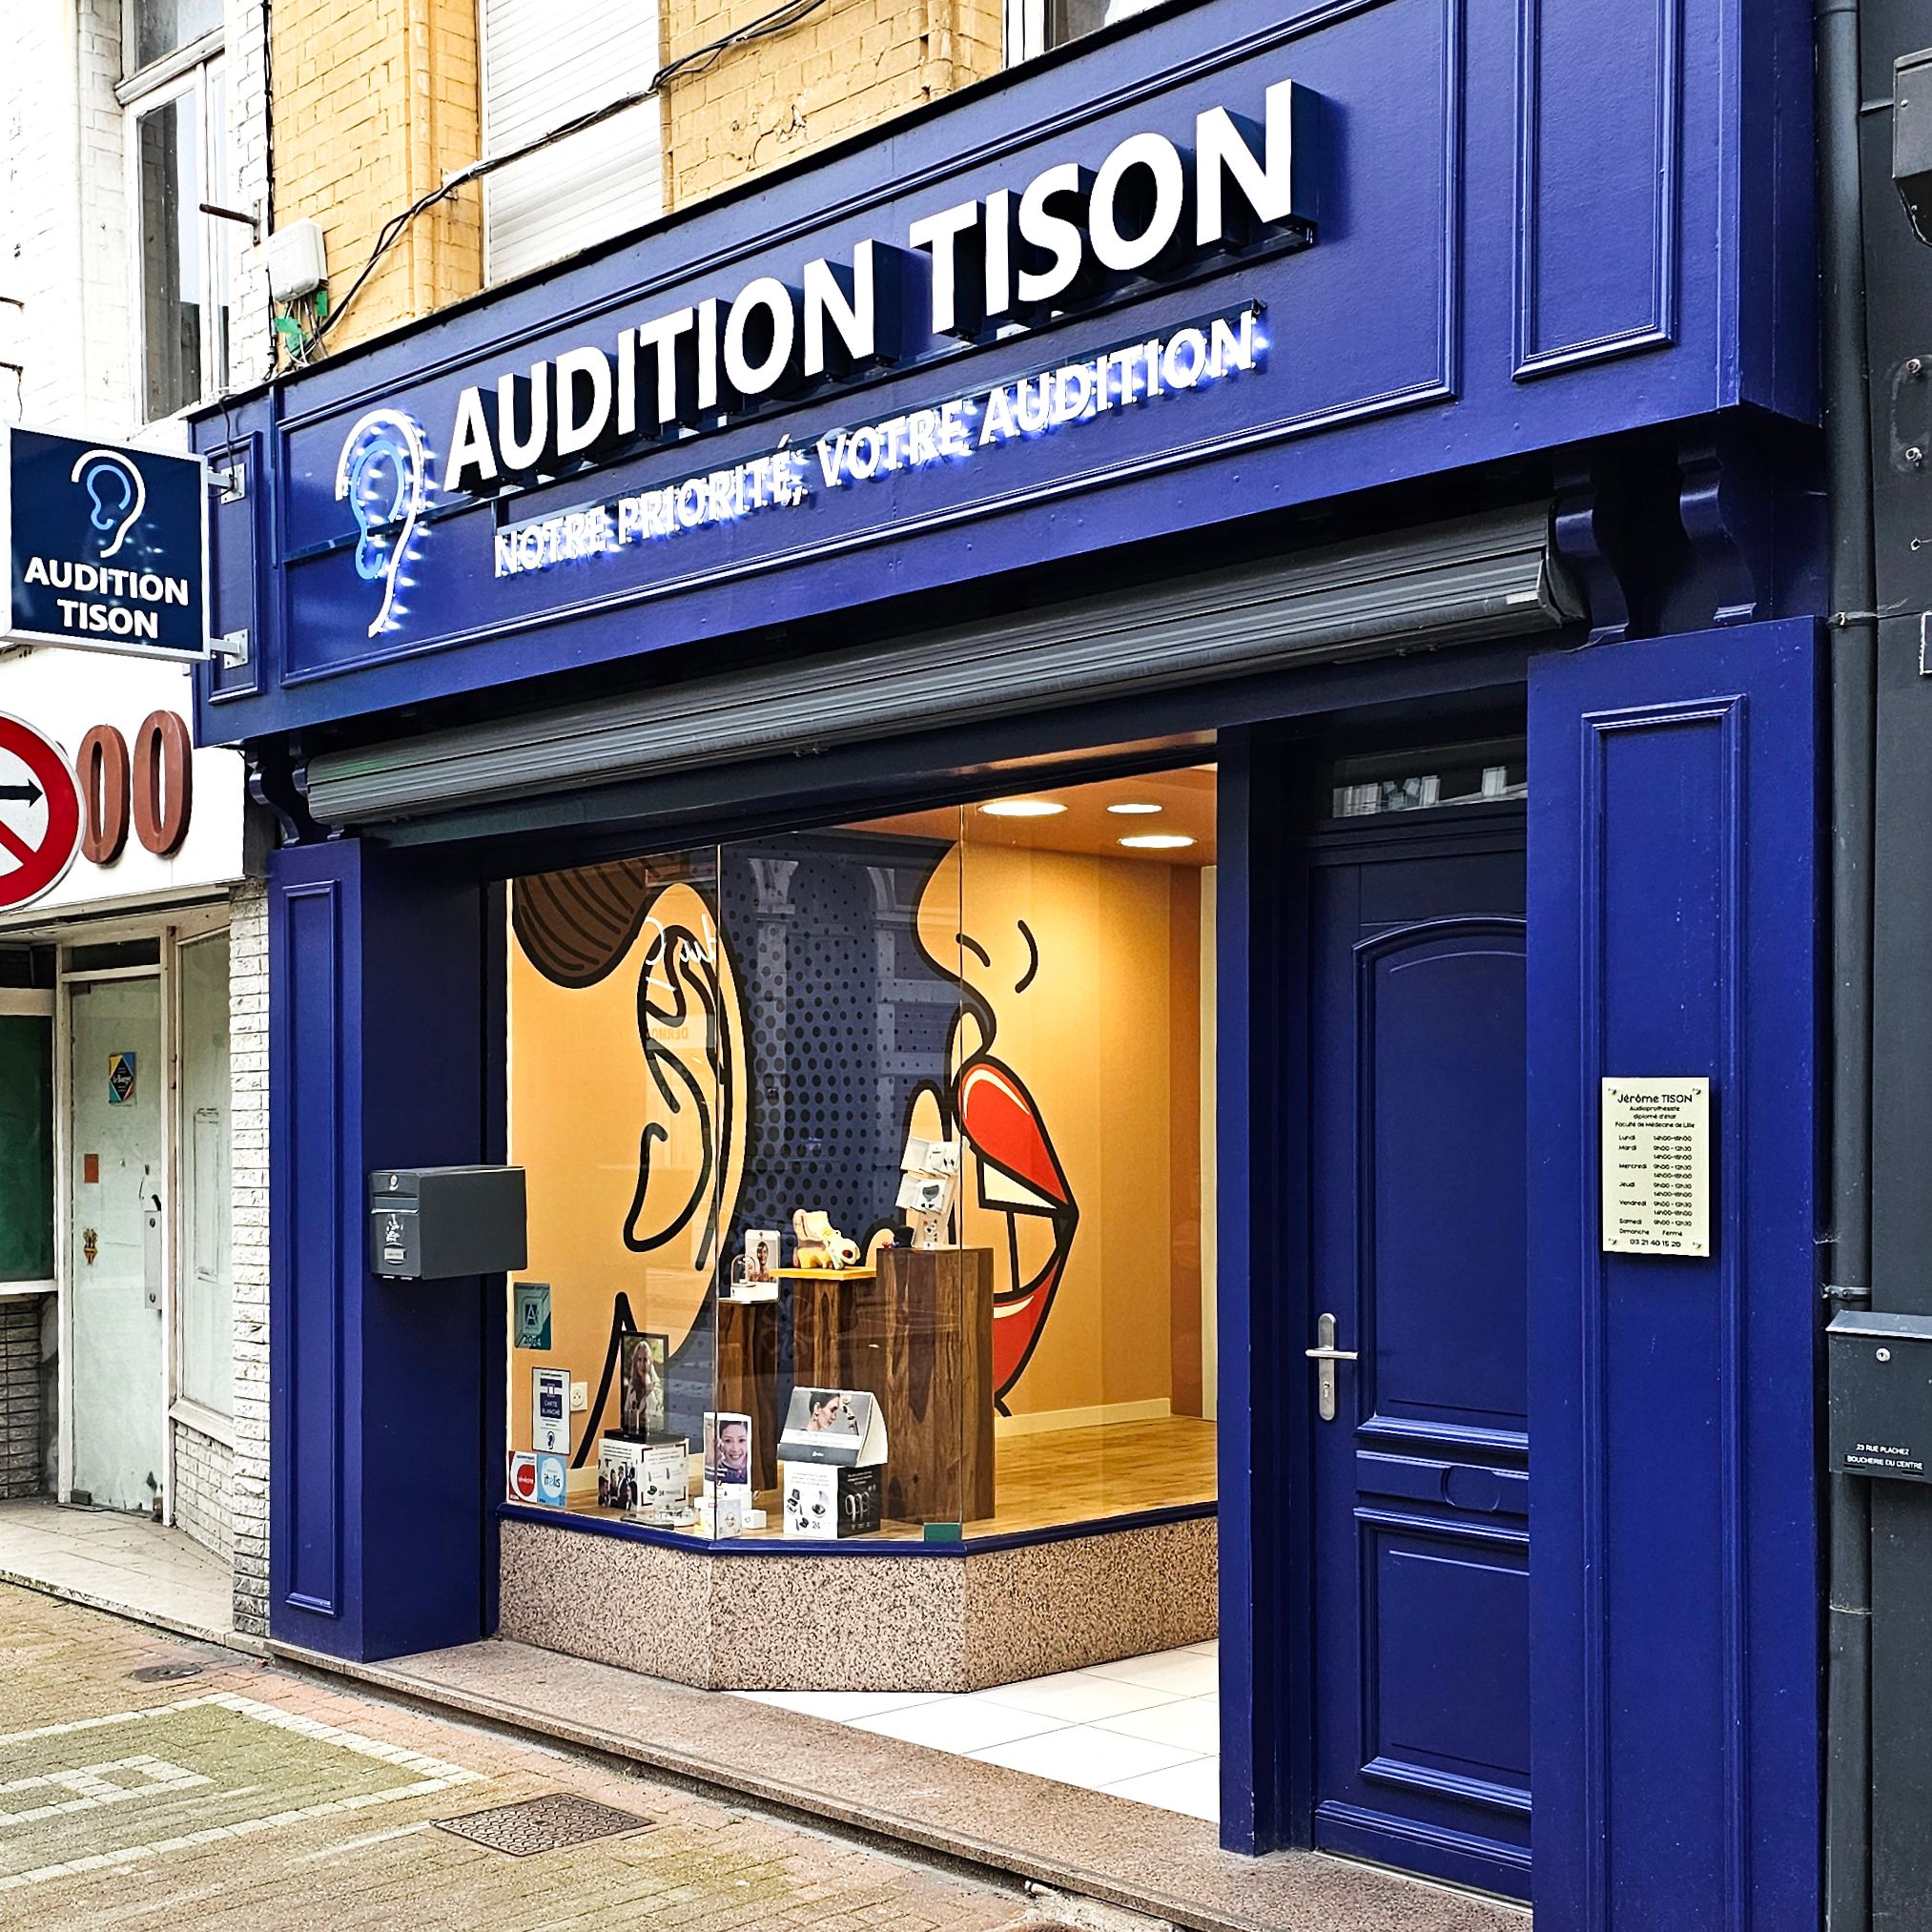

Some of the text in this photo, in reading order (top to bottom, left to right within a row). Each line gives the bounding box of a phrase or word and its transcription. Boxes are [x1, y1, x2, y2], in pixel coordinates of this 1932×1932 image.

[443, 78, 1292, 493] AUDITION TISON
[494, 310, 1253, 578] NOTRE PRIORITÉ, VOTRE AUDITION
[24, 556, 189, 606] AUDITION
[56, 598, 158, 639] TISON
[1617, 1094, 1693, 1103] Jérôme TISON
[1847, 1455, 1922, 1470] BOUCHERIE DU CENTRE
[1866, 1444, 1879, 1452] RUE
[1881, 1446, 1909, 1455] PLACHEZ
